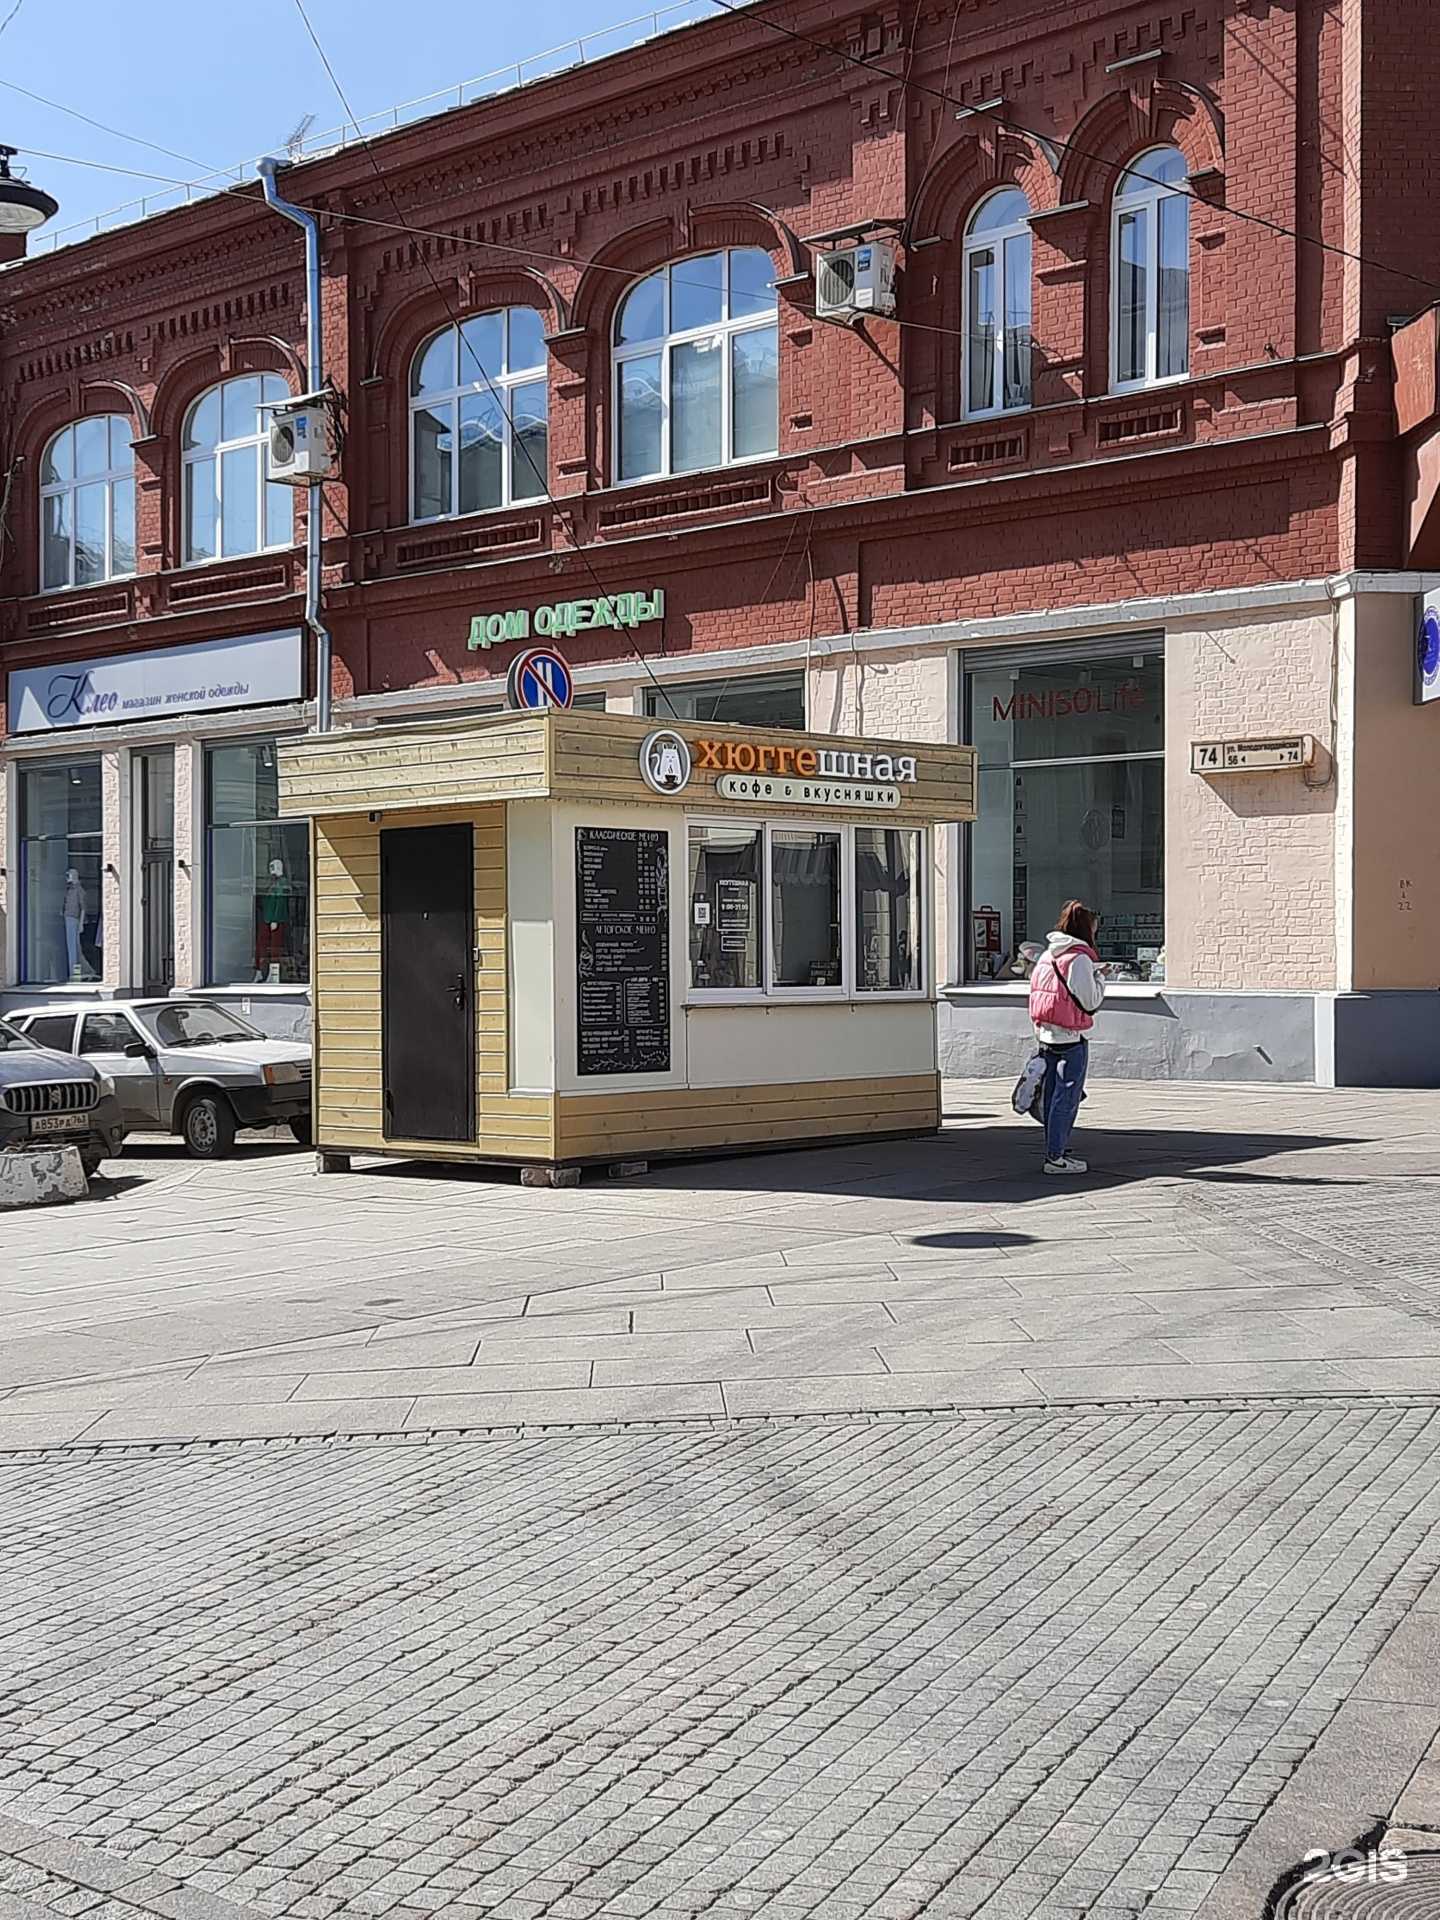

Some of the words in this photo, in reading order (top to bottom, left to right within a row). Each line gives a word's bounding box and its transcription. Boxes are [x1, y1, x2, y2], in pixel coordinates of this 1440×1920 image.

[468, 610, 530, 650] ДОМ
[533, 589, 665, 638] ОДЕЖДЫ
[47, 671, 118, 718] Клео
[122, 694, 162, 709] магазин
[165, 686, 207, 705] женской
[208, 682, 250, 698] одежды
[697, 741, 918, 782] хюггешная
[1199, 747, 1218, 765] 74
[1287, 751, 1299, 762] 74
[729, 779, 772, 798] кофе
[804, 787, 895, 804] вкусняшки
